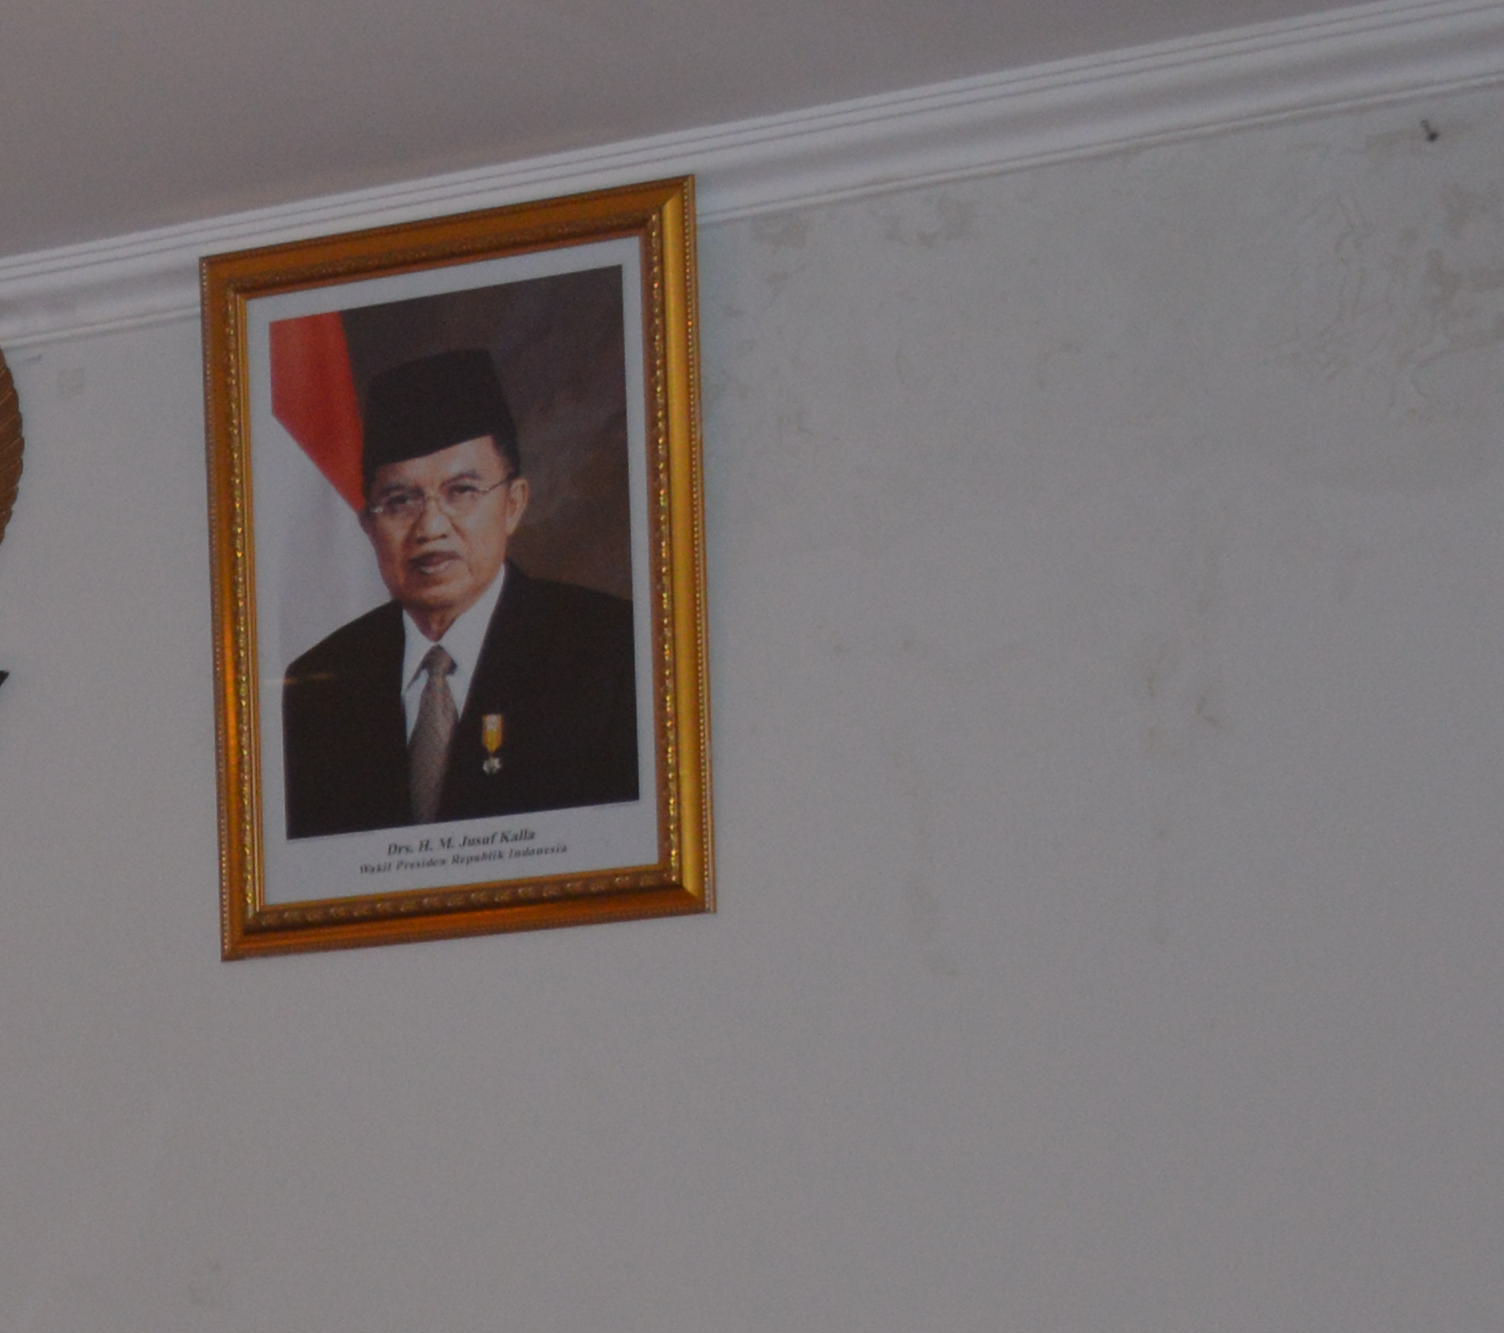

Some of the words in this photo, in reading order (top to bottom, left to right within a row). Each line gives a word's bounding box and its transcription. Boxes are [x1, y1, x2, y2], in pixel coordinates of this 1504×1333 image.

[387, 842, 414, 857] Drs.
[418, 839, 433, 852] H.
[440, 836, 453, 850] M.
[458, 832, 497, 848] Jusuf
[500, 828, 536, 844] Kalla
[359, 860, 392, 874] Wakil
[396, 857, 447, 871] Presiden
[508, 844, 568, 859] Indonesia
